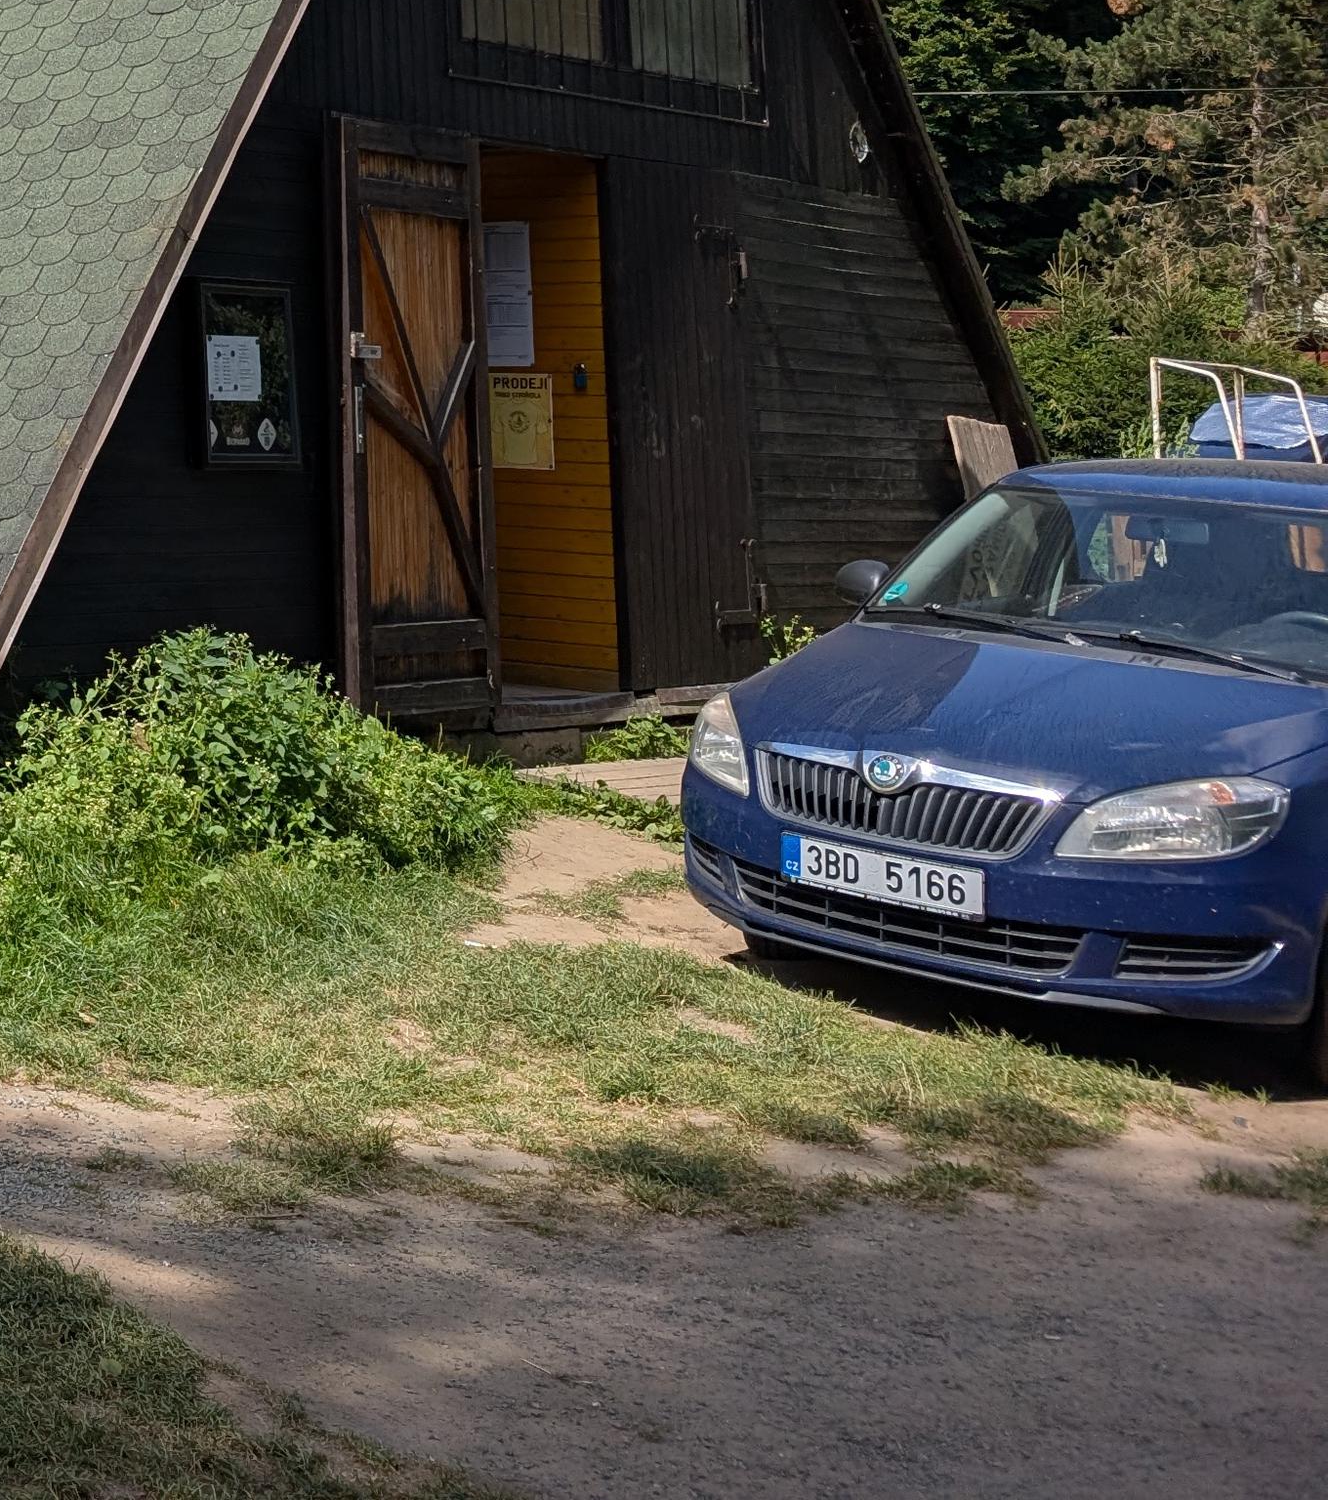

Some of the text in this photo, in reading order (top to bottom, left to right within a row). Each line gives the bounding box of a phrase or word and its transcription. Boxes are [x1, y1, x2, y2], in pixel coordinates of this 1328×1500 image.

[785, 860, 799, 871] CZ
[807, 845, 860, 884] 3BD
[885, 861, 966, 905] 5166
